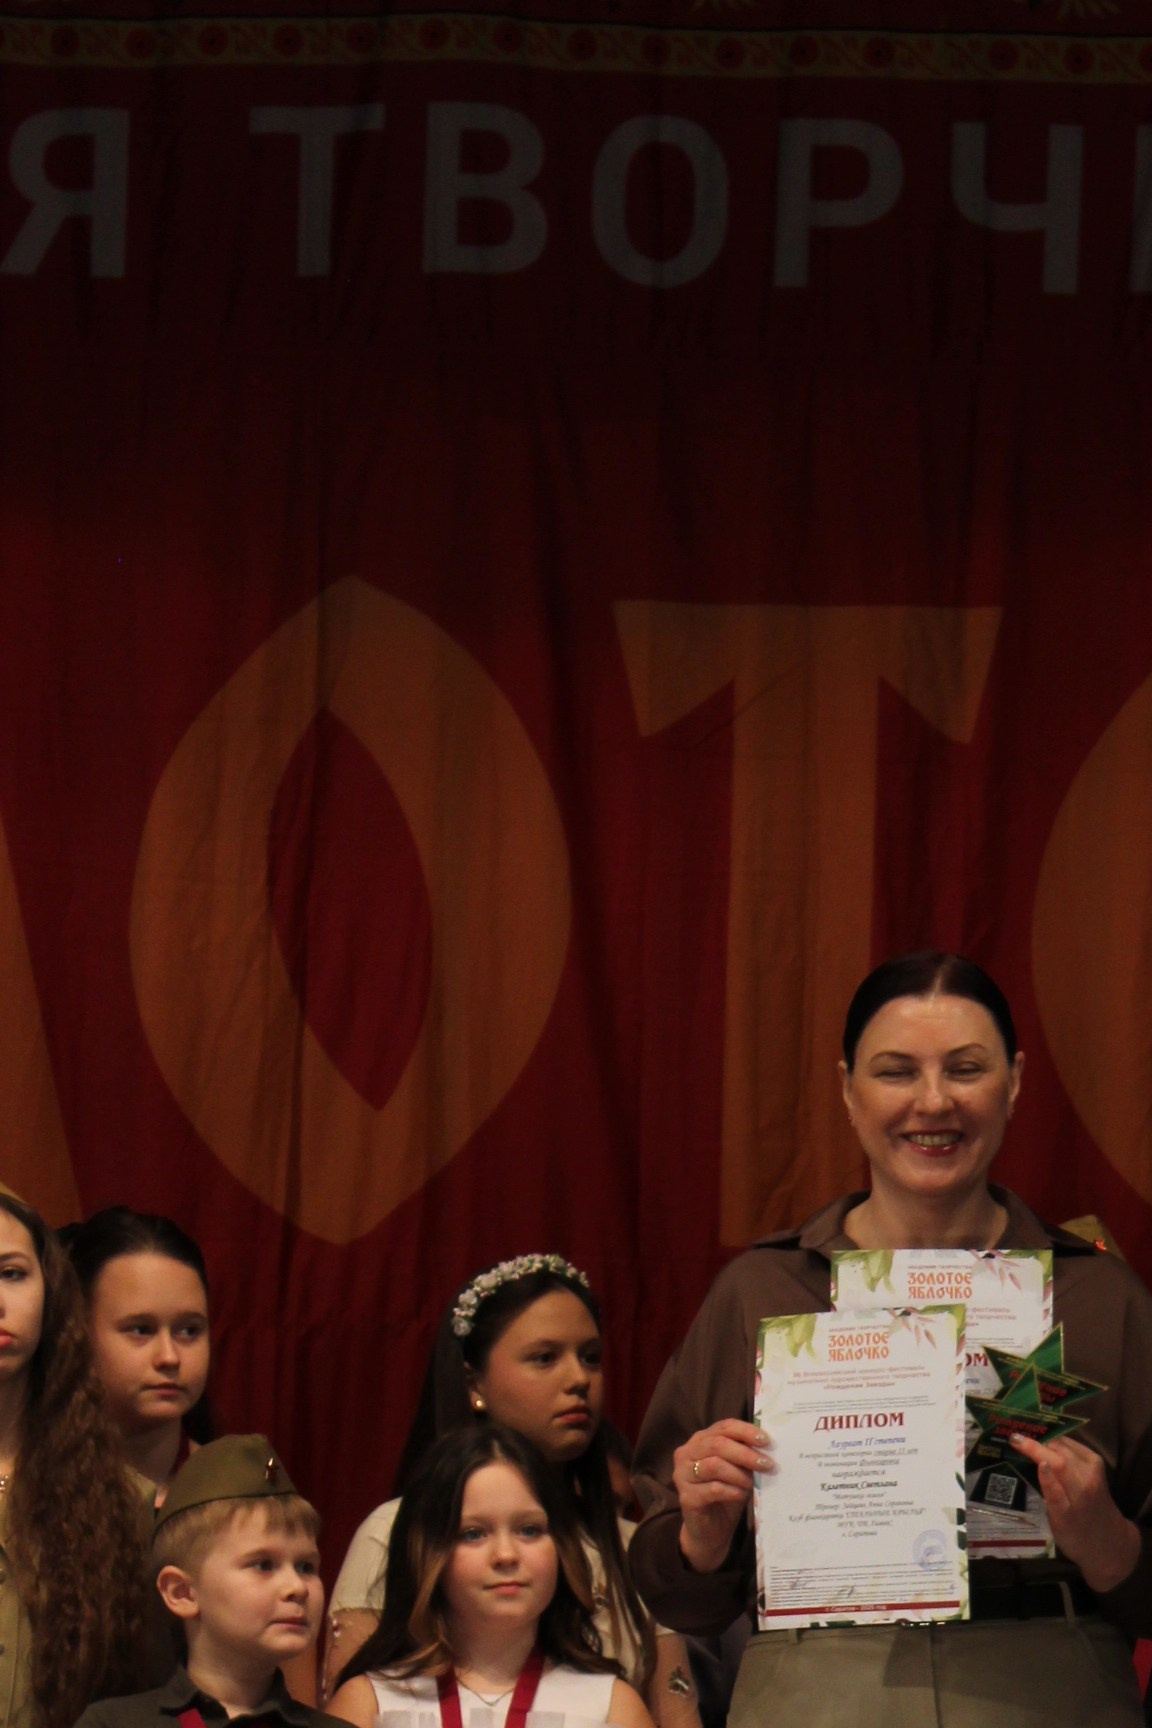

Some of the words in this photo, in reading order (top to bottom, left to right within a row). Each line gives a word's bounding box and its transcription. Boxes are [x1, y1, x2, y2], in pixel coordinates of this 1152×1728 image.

[0, 107, 131, 279] Я
[907, 1271, 973, 1285] ЗОЛОТОЕ
[907, 1286, 974, 1300] ЯБЛОЧКО
[828, 1331, 890, 1348] ЗОЛОТОЕ
[828, 1346, 890, 1362] ЯБЛОЧКО
[813, 1412, 905, 1432] ДИПЛОМ
